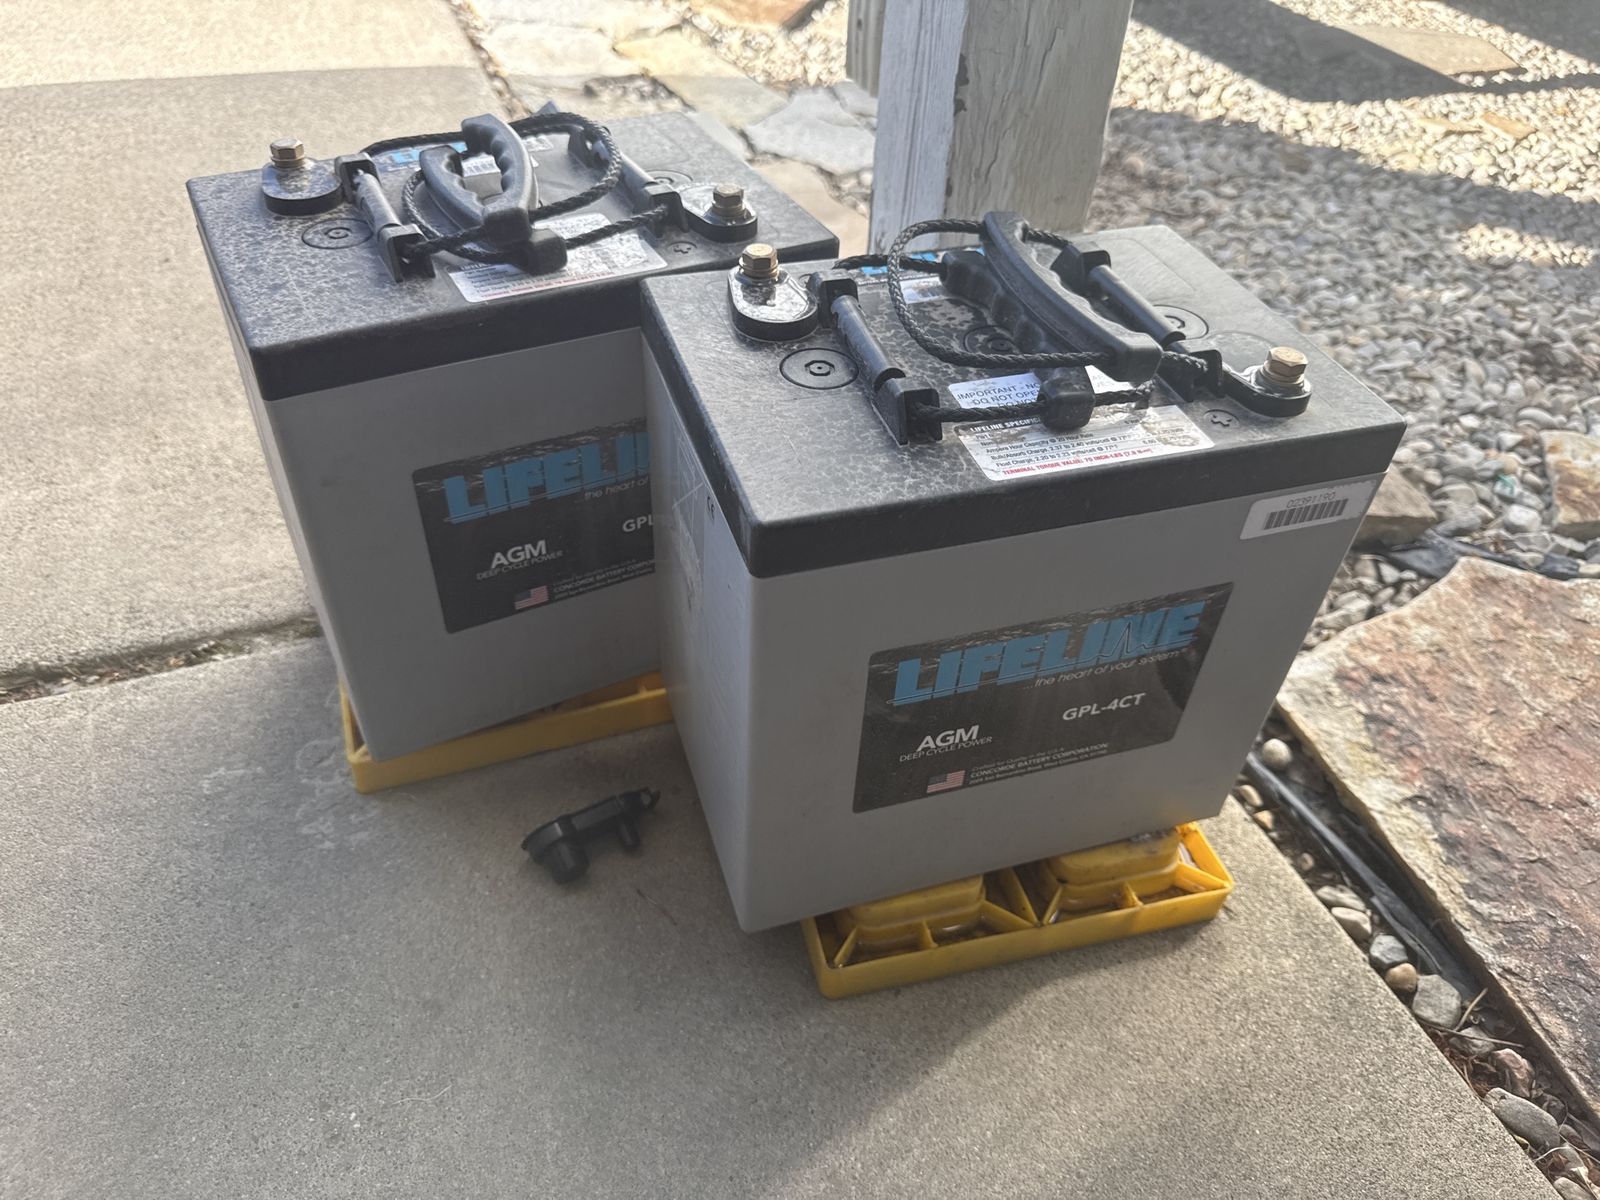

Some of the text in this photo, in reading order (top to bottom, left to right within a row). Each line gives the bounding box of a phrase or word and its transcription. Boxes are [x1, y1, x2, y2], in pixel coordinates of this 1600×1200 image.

[957, 385, 1018, 400] IMPORTANT
[971, 388, 1040, 406] DO NOT OPE
[969, 423, 1005, 433] LIFELINE
[1008, 442, 1024, 450] Hour
[1023, 439, 1050, 449] Capacity
[1049, 444, 1063, 452] 2.37
[1002, 465, 1035, 476] TERMINAL
[1036, 461, 1061, 471] TORQUE
[1061, 458, 1084, 468] VALUE:
[1093, 451, 1124, 462] INCH-LBS
[1035, 454, 1049, 462] 2.20
[604, 479, 635, 497] heart
[476, 550, 563, 581] DEEP CYCLE POWER
[490, 540, 548, 569] AGM
[553, 576, 595, 593] CONCORDE
[890, 597, 1206, 706] LIFELINE
[1056, 667, 1094, 684] heart
[1093, 663, 1110, 675] of
[1108, 658, 1136, 673] your
[1137, 649, 1182, 666] system
[1061, 692, 1147, 721] GPL-4CT
[899, 735, 993, 762] DEEP CYCLE POWER
[915, 724, 980, 753] AGM
[970, 763, 1017, 779] CONCORDE
[1017, 754, 1052, 768] BATTERY
[1051, 742, 1110, 760] CORPORATION
